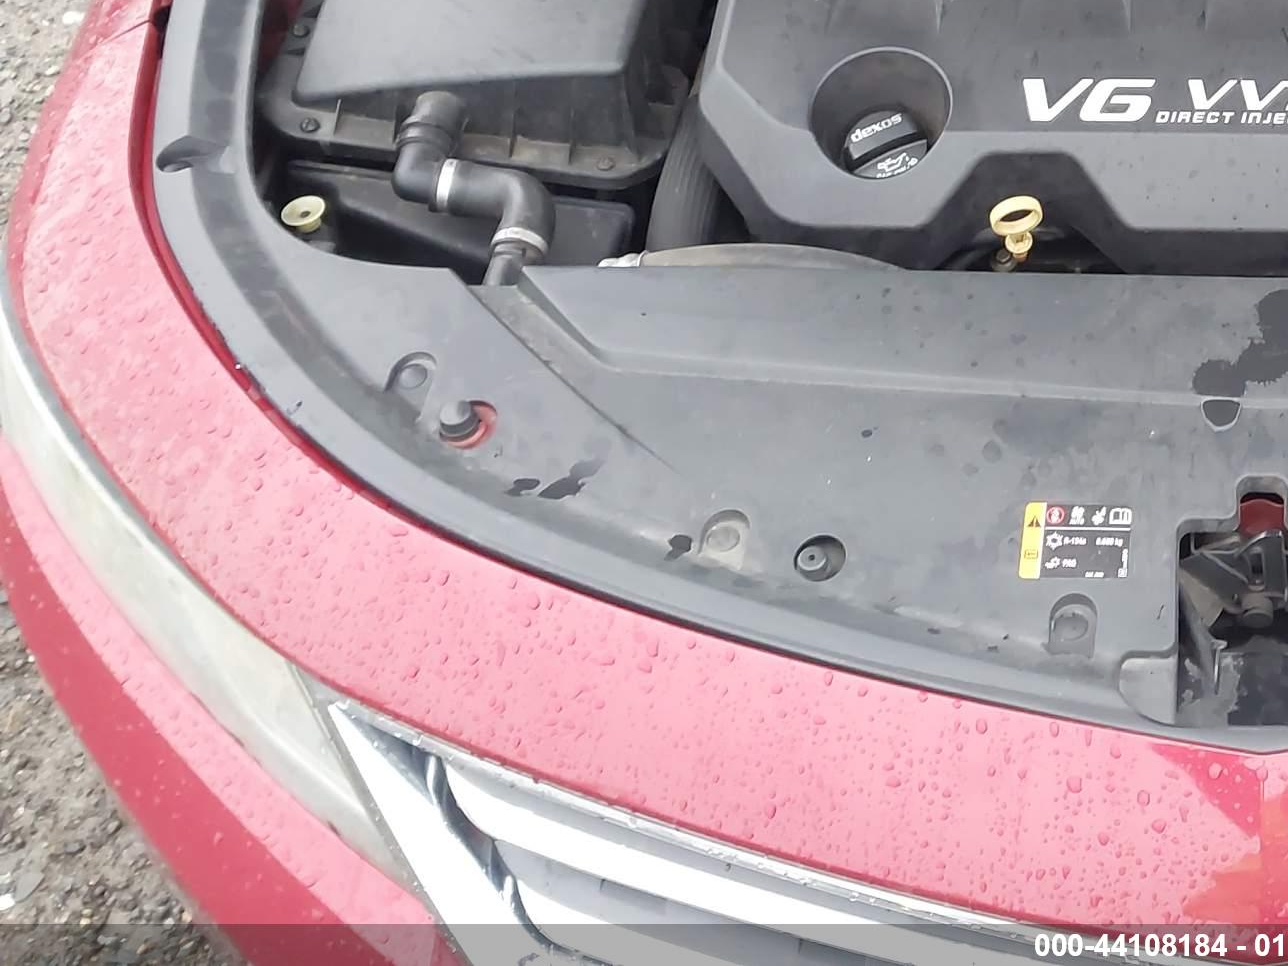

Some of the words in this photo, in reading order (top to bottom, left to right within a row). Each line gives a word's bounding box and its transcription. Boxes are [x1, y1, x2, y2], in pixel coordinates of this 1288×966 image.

[1022, 78, 1157, 122] V6
[850, 113, 903, 143] dexos
[1155, 111, 1236, 125] DIRECT
